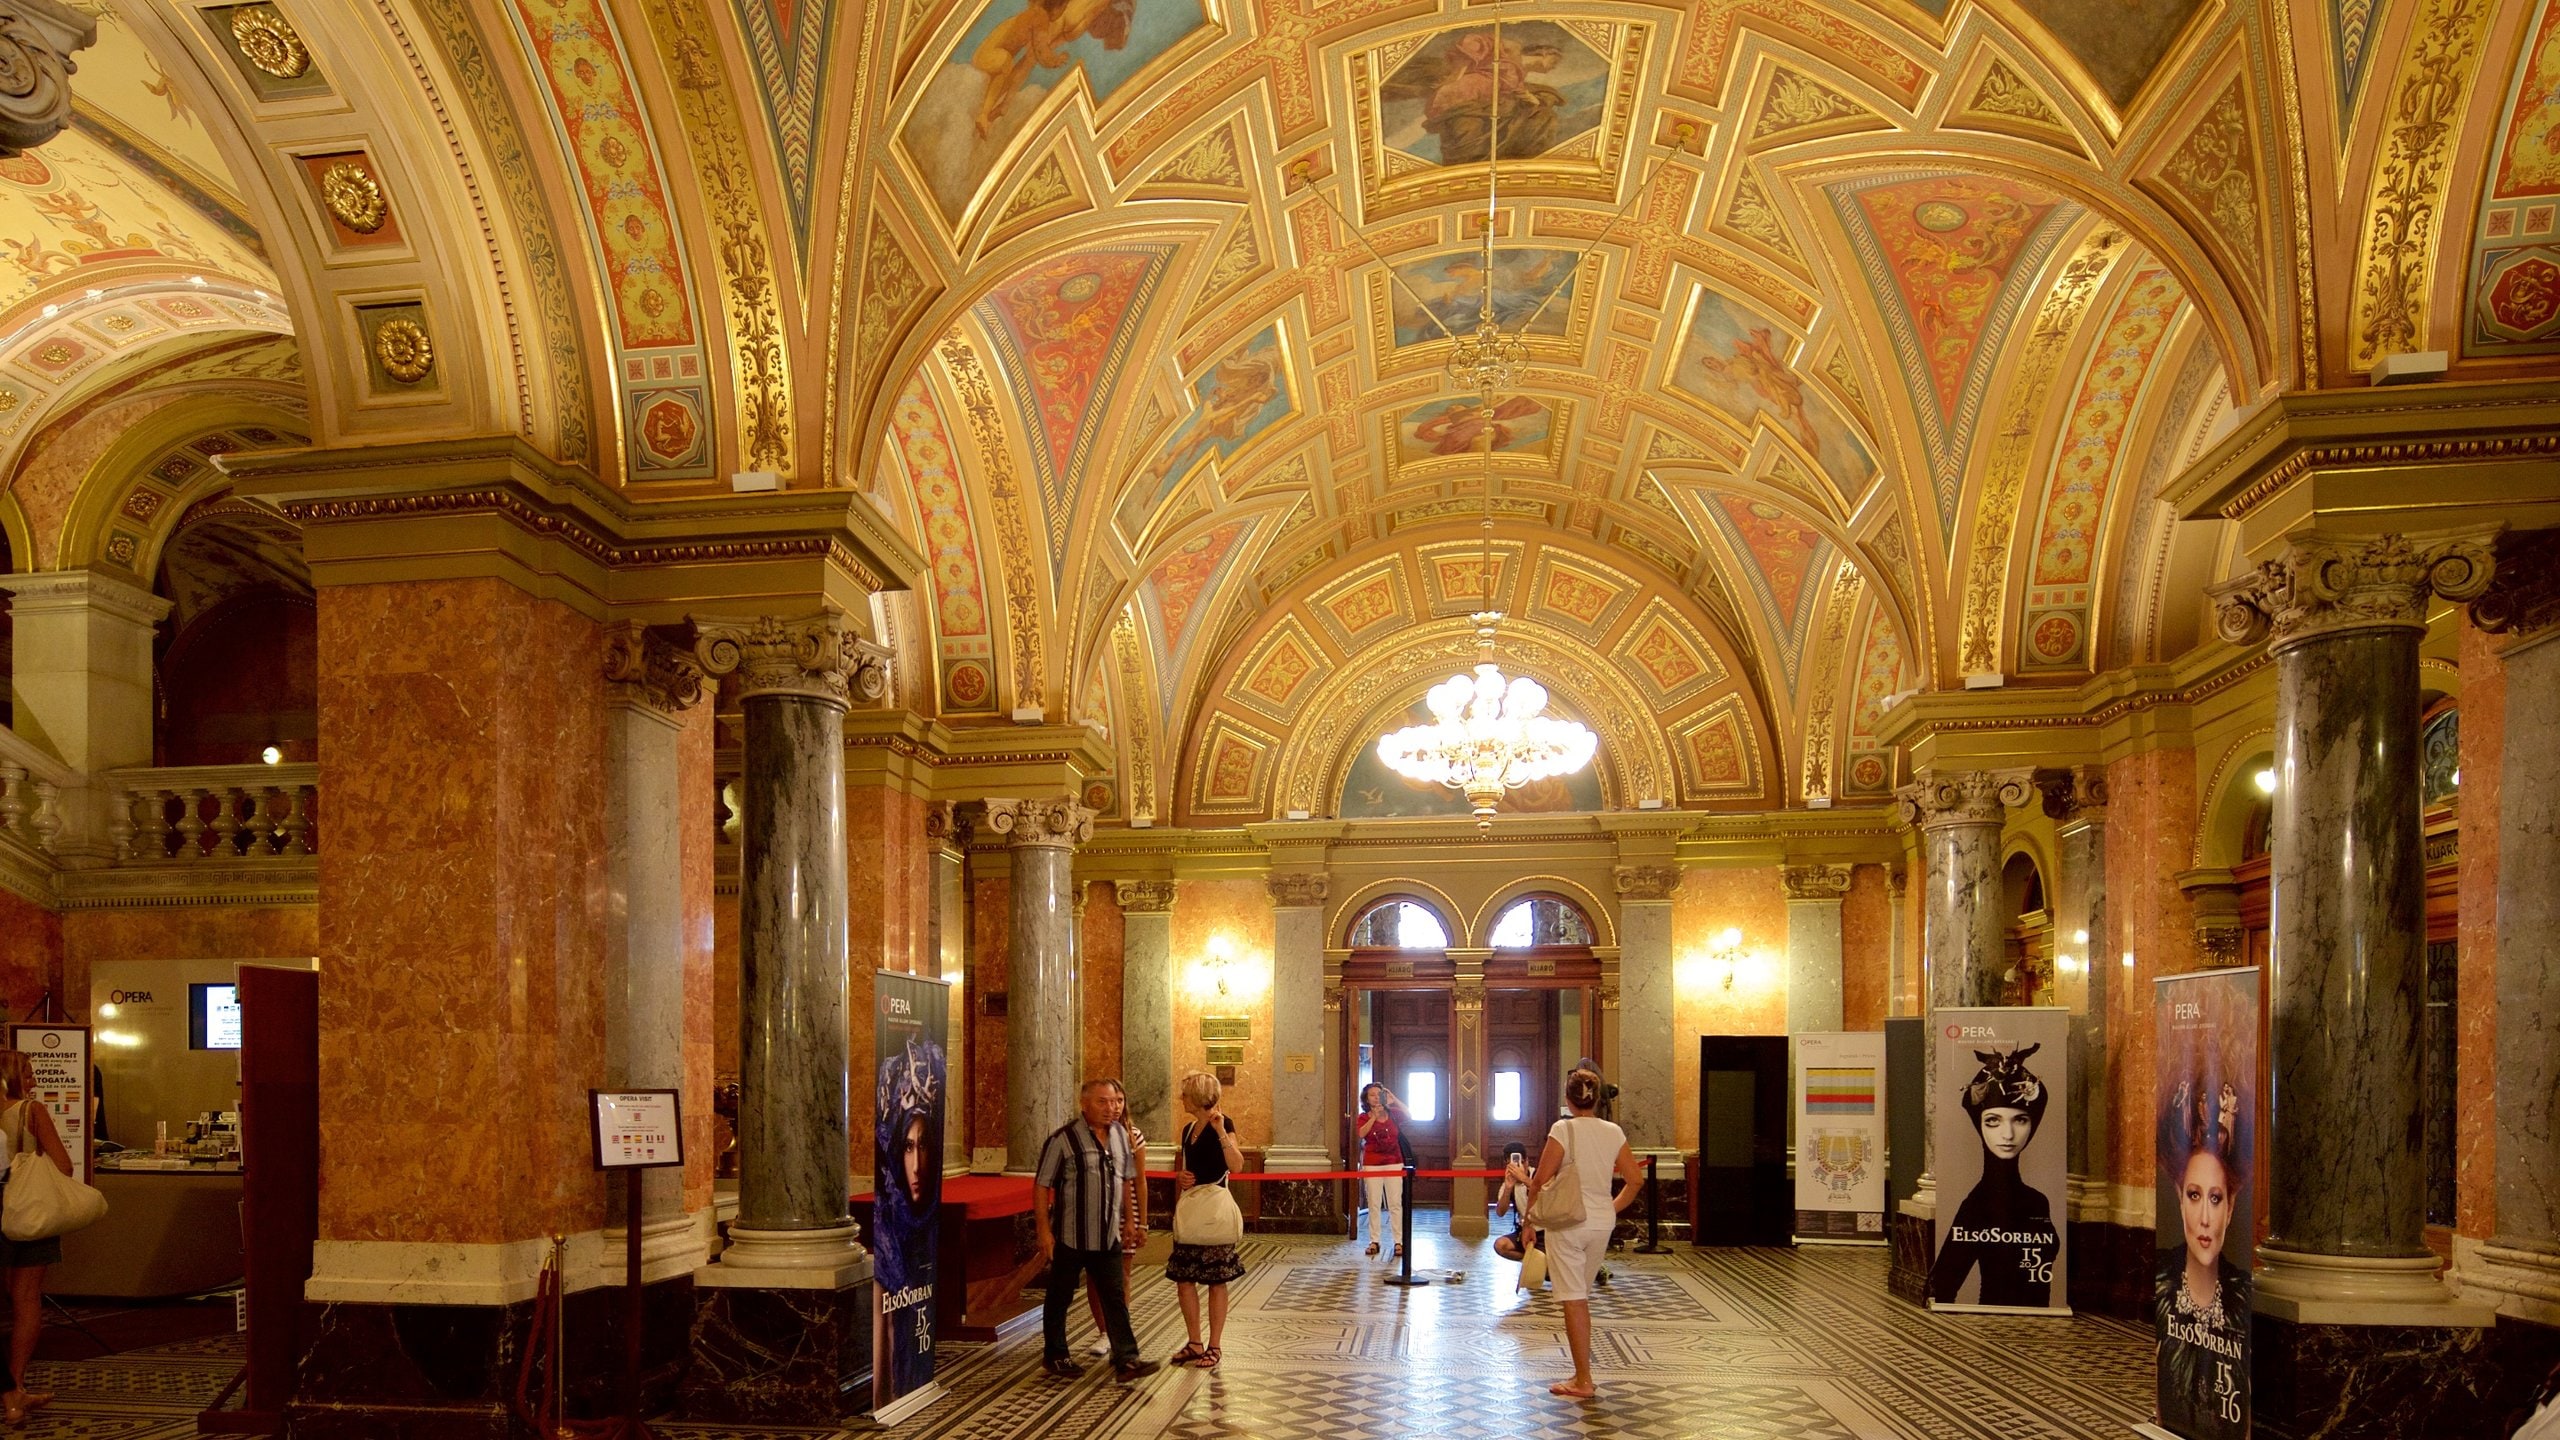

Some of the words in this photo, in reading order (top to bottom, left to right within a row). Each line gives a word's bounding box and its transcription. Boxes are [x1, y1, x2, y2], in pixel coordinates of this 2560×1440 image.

[110, 989, 153, 1004] OPERA
[881, 993, 911, 1015] OPERA
[1945, 1024, 1996, 1040] OPERA
[2022, 1247, 2042, 1269] 15
[2028, 1262, 2053, 1283] 16
[916, 1305, 927, 1336] 15
[918, 1322, 931, 1355] 16
[2216, 1361, 2232, 1395] 15
[2220, 1390, 2241, 1423] 16
